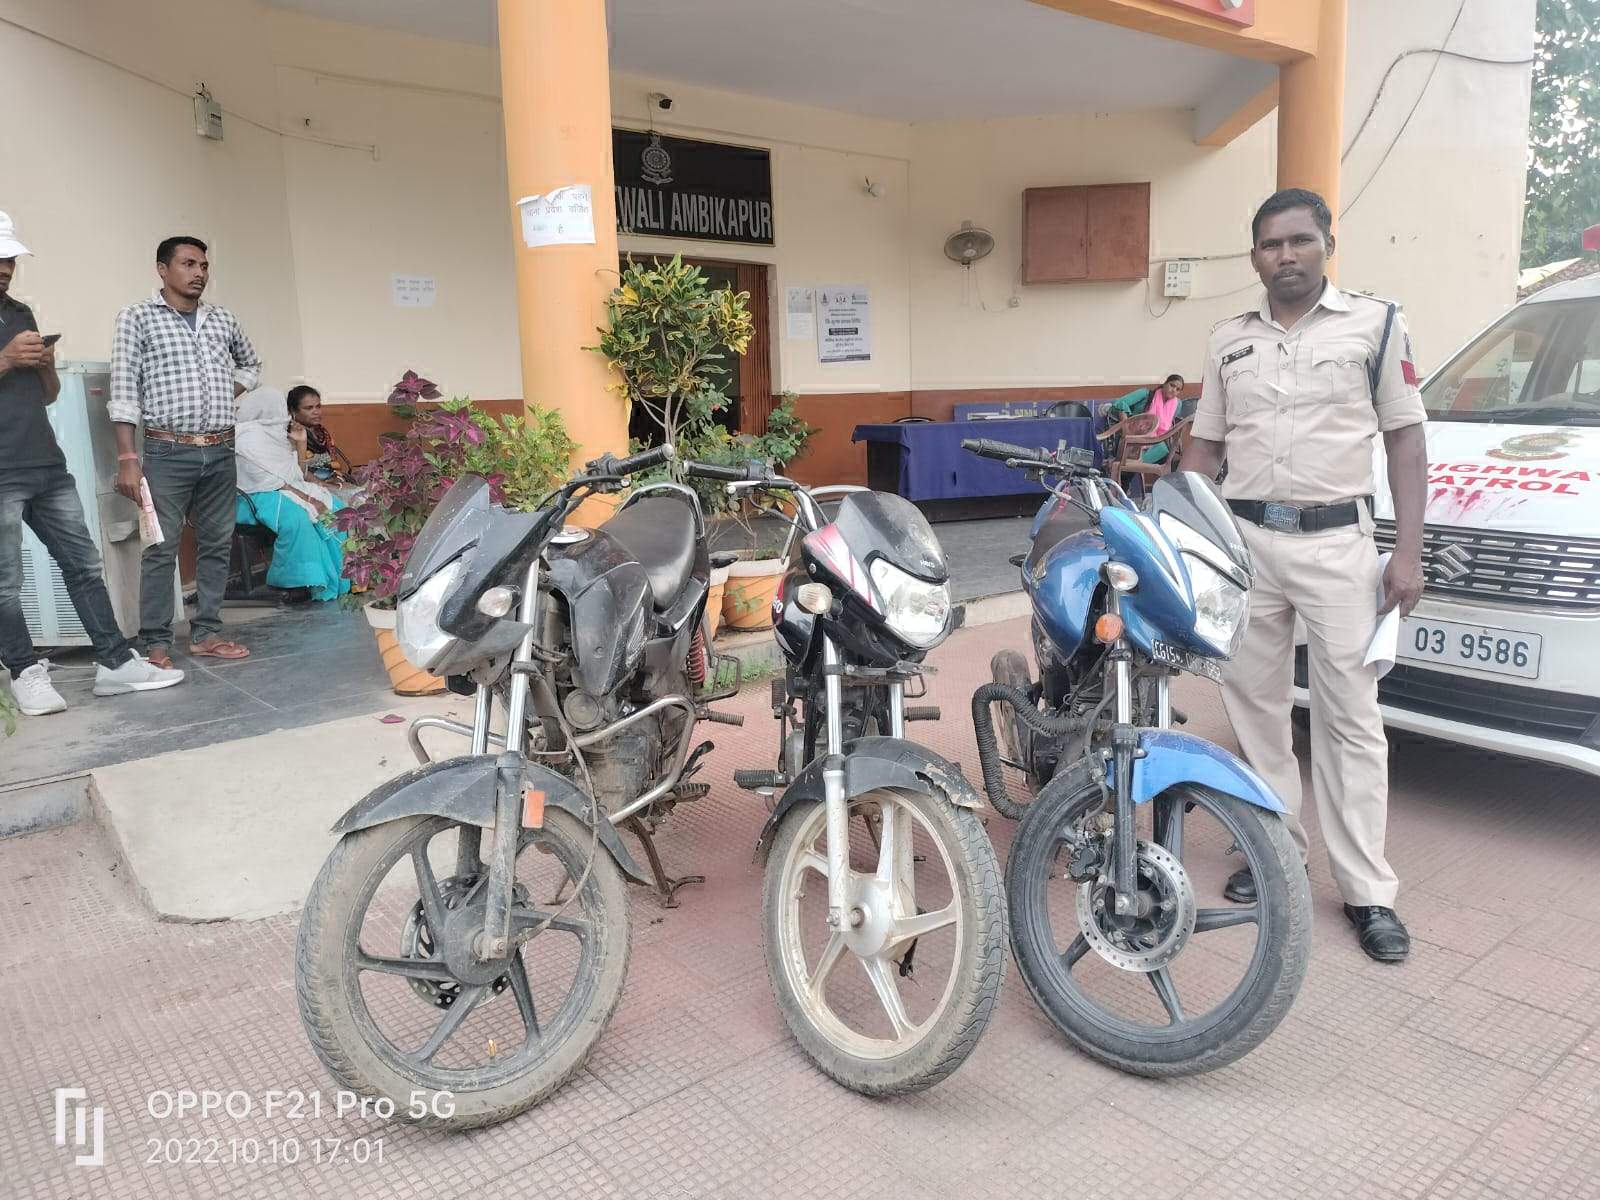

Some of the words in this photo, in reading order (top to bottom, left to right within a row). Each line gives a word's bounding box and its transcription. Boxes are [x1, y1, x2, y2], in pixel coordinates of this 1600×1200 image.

[615, 186, 664, 230] WALI
[670, 192, 772, 239] AMBIKAPUR
[1425, 463, 1600, 482] IGHWA
[1427, 475, 1579, 495] ATROL
[1415, 627, 1445, 654] 03
[1460, 633, 1530, 667] 9586
